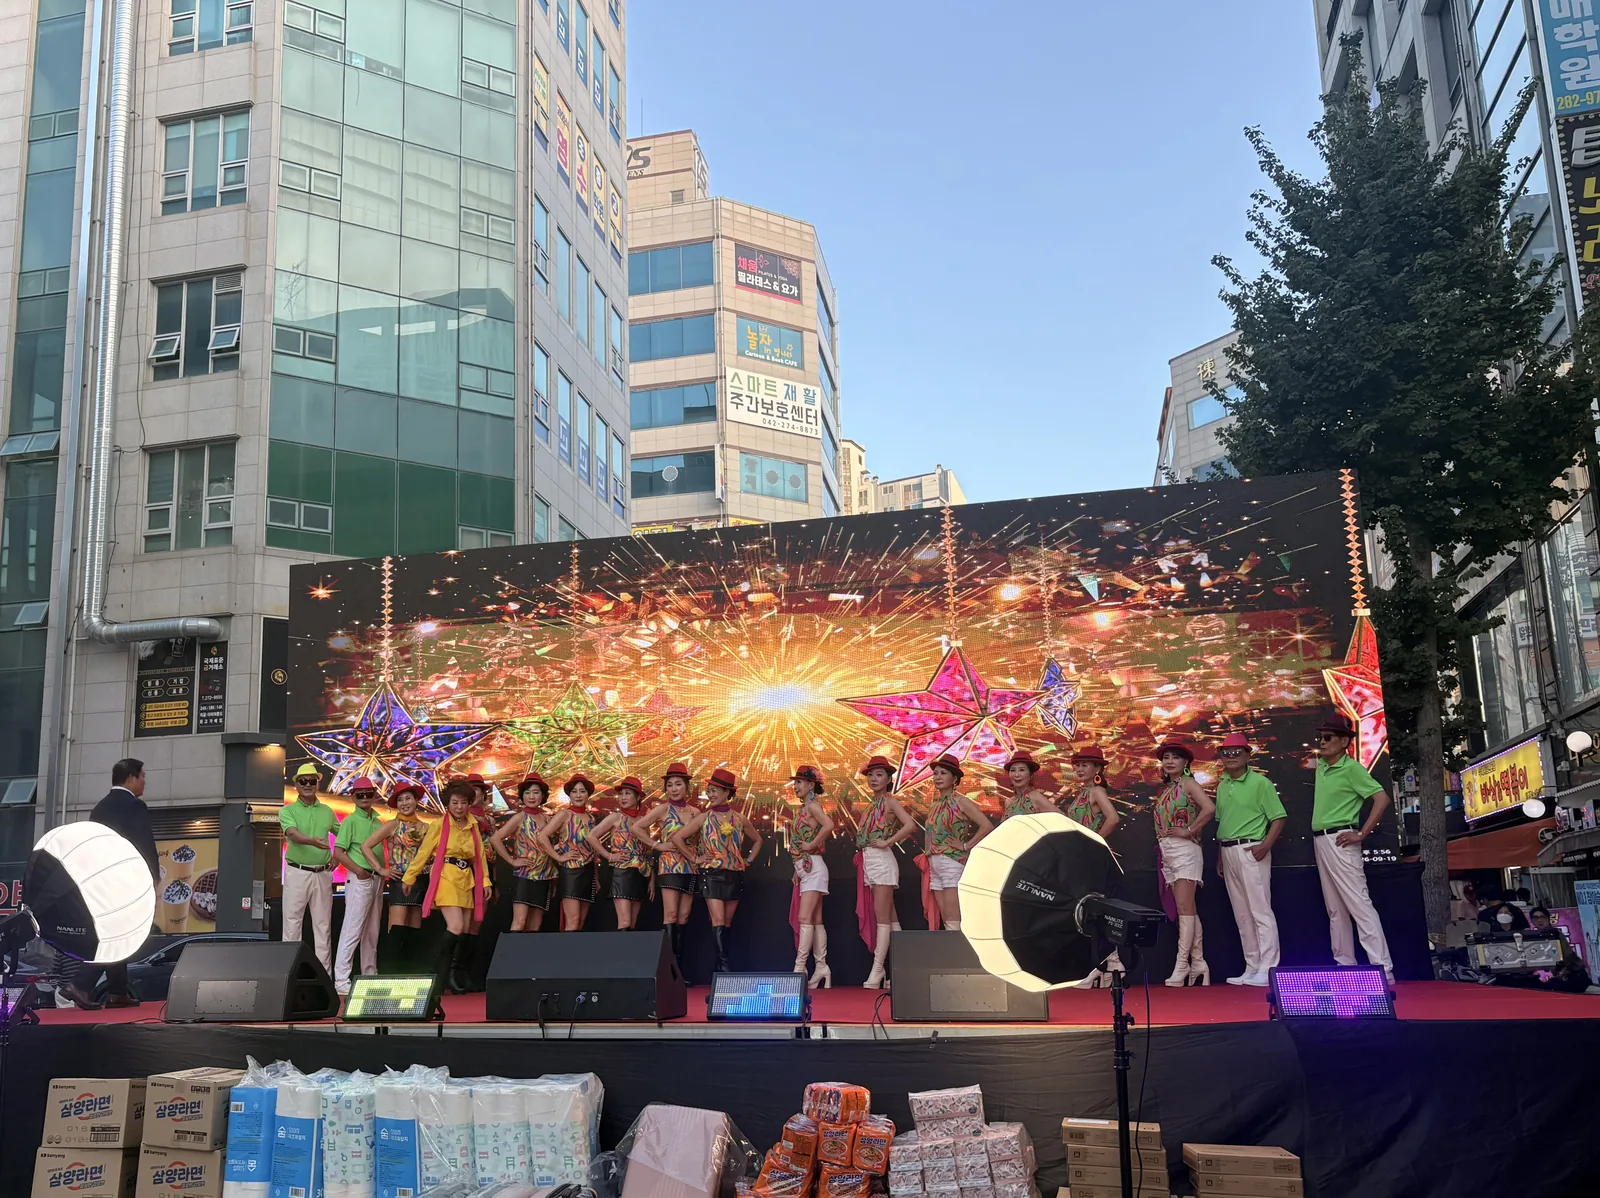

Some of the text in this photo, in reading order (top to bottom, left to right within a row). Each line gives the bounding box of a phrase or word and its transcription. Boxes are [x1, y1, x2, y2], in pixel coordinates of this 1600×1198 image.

[738, 271, 798, 297] 필라테스 & 요가
[747, 324, 772, 350] 놀자
[730, 371, 778, 398] 스마트
[730, 391, 818, 427] 주간보호센터
[762, 418, 819, 435] 042-274-8873
[1015, 882, 1055, 901] NANLITE
[61, 1095, 111, 1119] 삼양라면
[156, 1101, 201, 1118] 삼양라면
[49, 1165, 103, 1188] 삼양라면
[152, 1165, 203, 1185] 삼양라면
